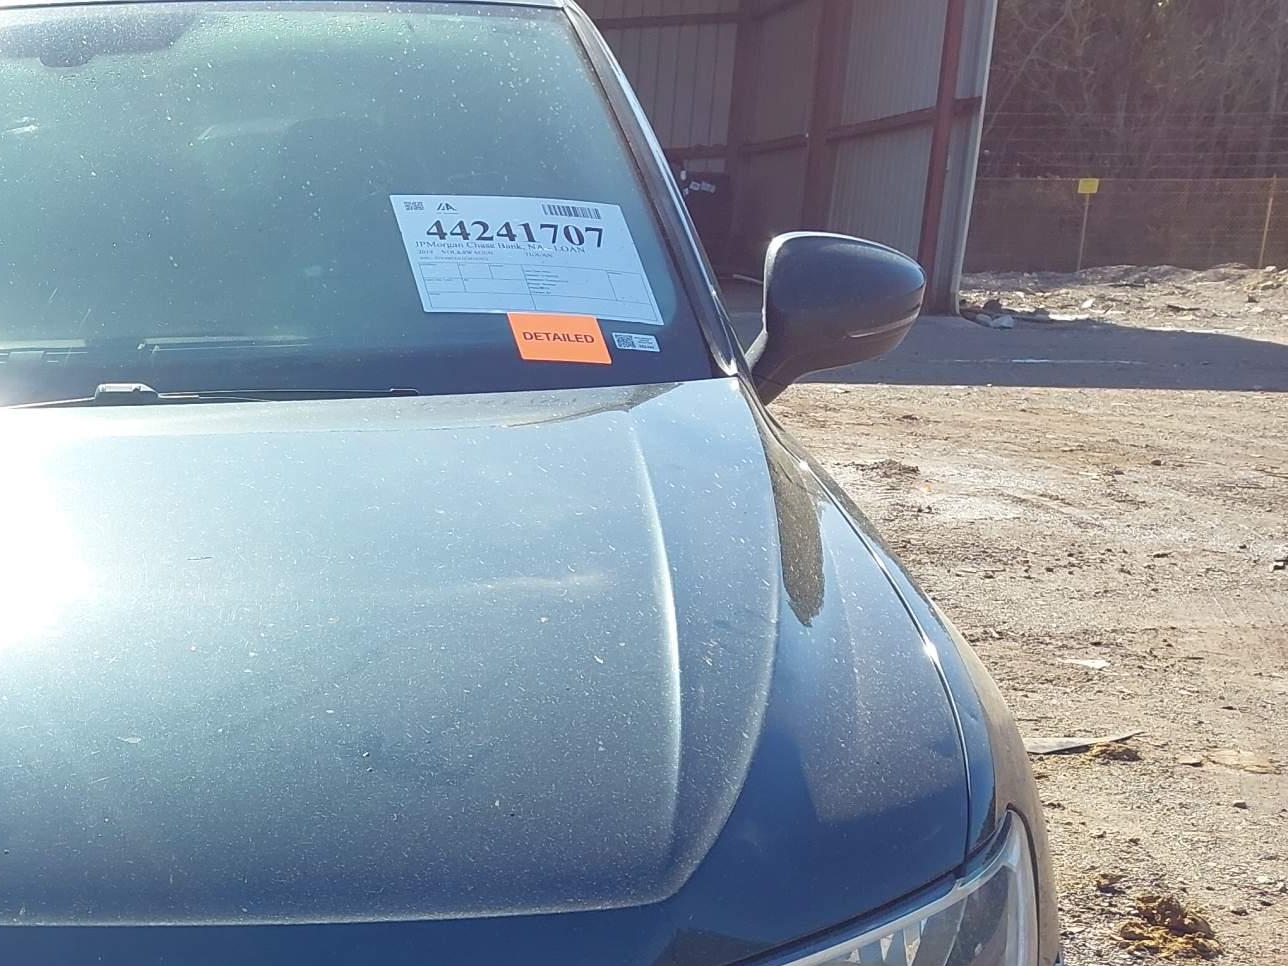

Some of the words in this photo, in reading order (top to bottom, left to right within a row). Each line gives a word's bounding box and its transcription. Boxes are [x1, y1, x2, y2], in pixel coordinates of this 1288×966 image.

[426, 220, 603, 248] 44241707
[415, 241, 464, 249] JPMorgan
[466, 241, 496, 249] Chase
[523, 331, 595, 344] DETAILED
